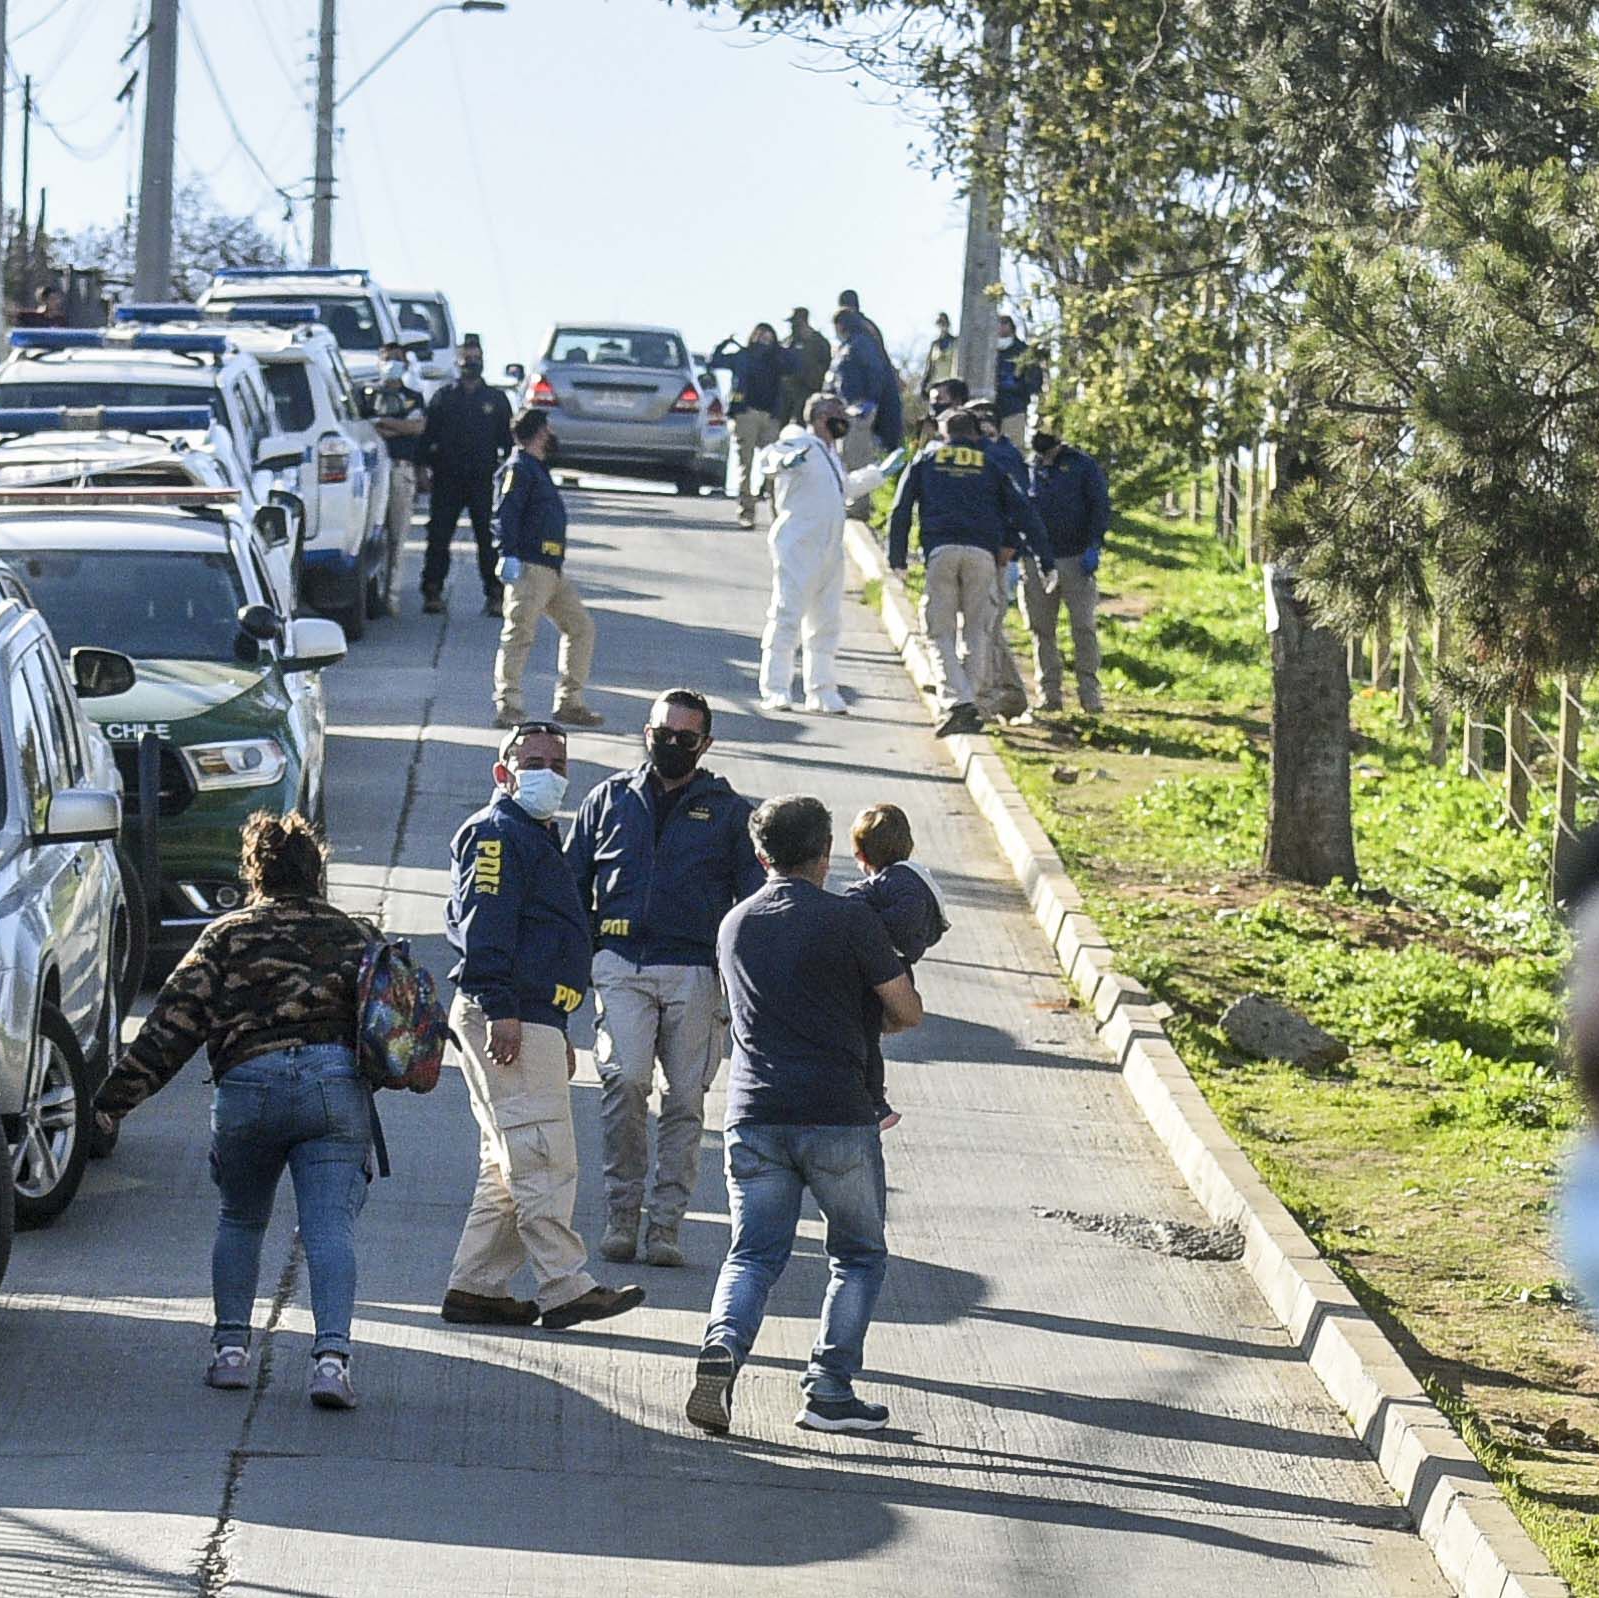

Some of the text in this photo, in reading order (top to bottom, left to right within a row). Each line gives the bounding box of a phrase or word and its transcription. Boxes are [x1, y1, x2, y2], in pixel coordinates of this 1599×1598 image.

[936, 446, 985, 467] PDI
[106, 723, 172, 741] CHILE
[476, 840, 501, 885] PDI
[552, 983, 583, 1013] PDI
